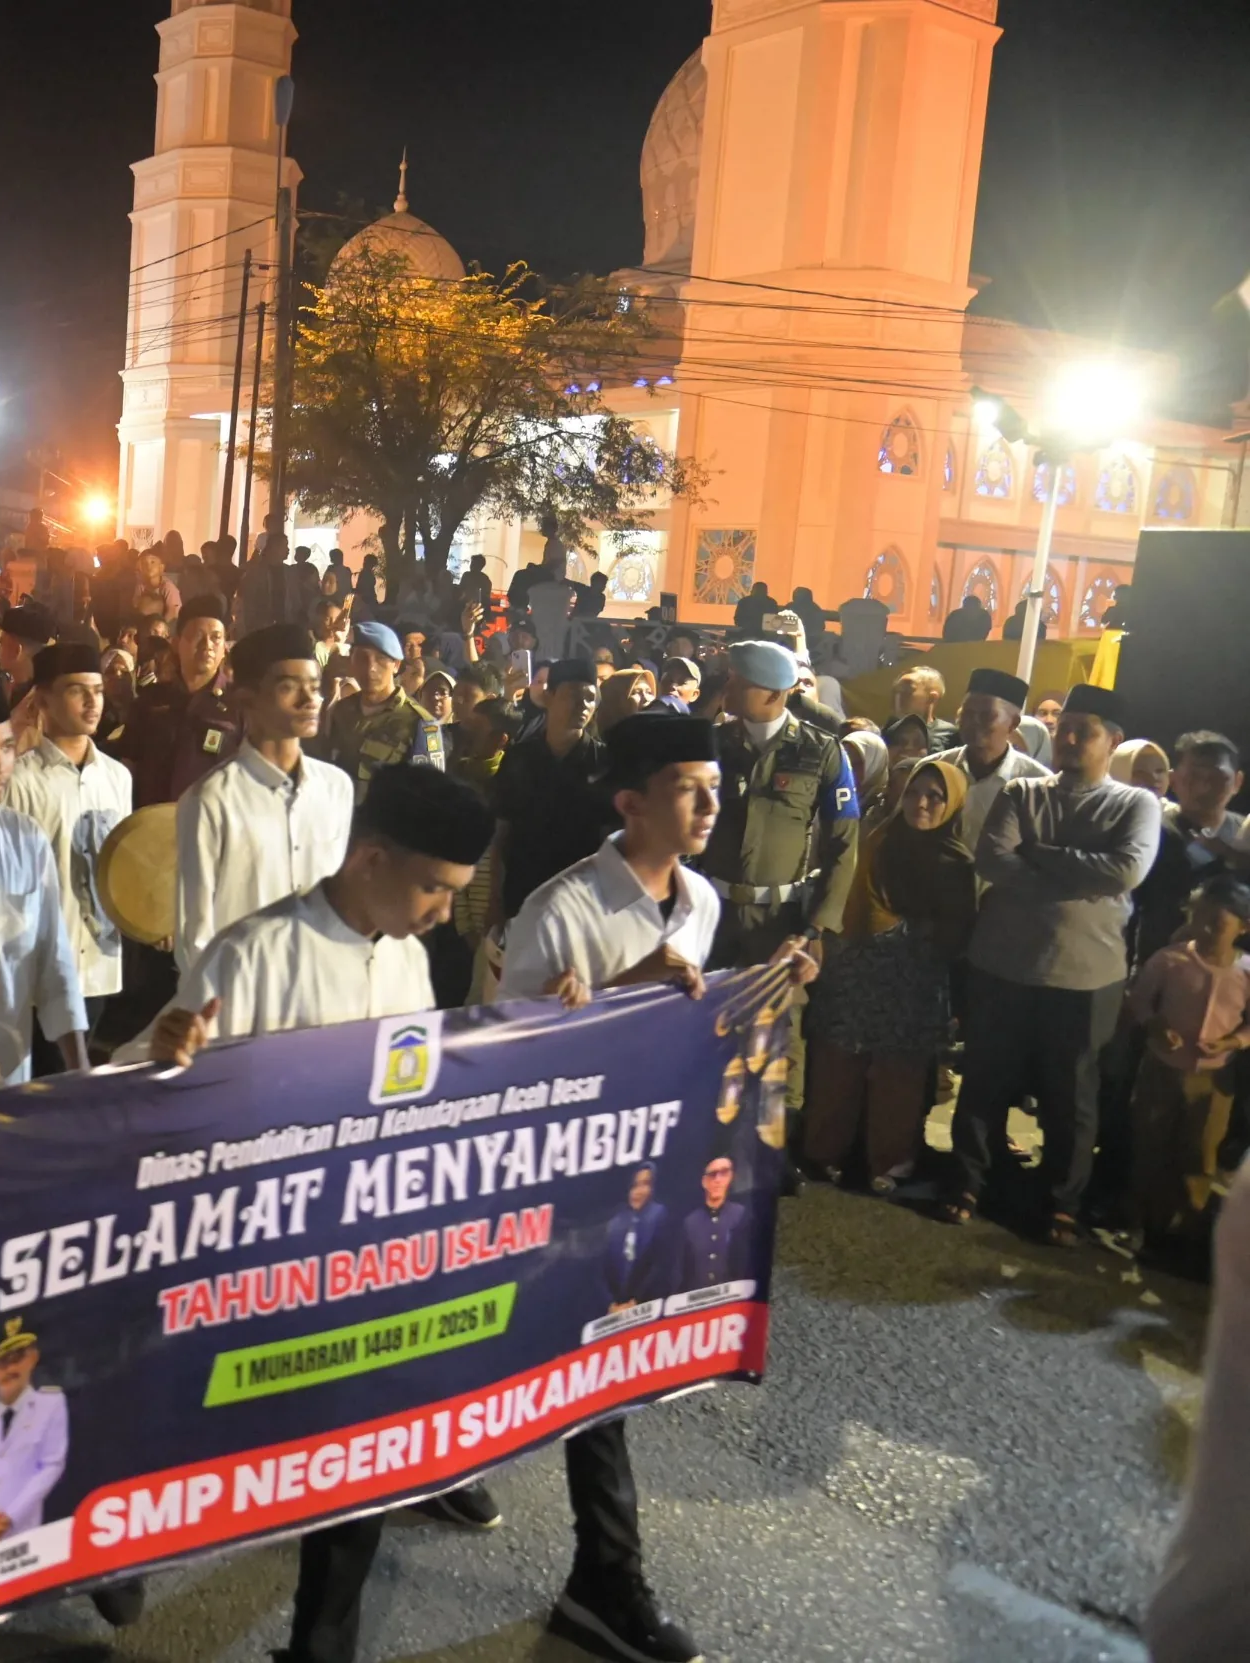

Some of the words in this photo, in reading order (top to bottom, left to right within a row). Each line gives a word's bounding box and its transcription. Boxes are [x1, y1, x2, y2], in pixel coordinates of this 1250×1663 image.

[136, 1149, 207, 1190] Dinas
[208, 1123, 336, 1174] Pendidikan
[335, 1115, 380, 1147] Dan
[379, 1092, 501, 1139] Kebudayaan
[500, 1080, 550, 1115] Aceh
[549, 1074, 606, 1106] Besar
[339, 1100, 682, 1225] MENYAMBUT
[157, 1256, 321, 1335] TAHUN
[324, 1229, 440, 1301] BARU
[441, 1203, 554, 1273] ISLAM
[234, 1362, 244, 1388] 1
[250, 1337, 357, 1386] MUHARRAM
[362, 1325, 403, 1359] 1448
[407, 1320, 420, 1347] H
[422, 1318, 434, 1343] /
[437, 1305, 479, 1339] 2026
[482, 1300, 498, 1326] M
[89, 1472, 223, 1547] SMP
[232, 1418, 424, 1514] NEGERI
[431, 1410, 451, 1458] 1
[457, 1313, 748, 1449] SUKAMAKMUR
